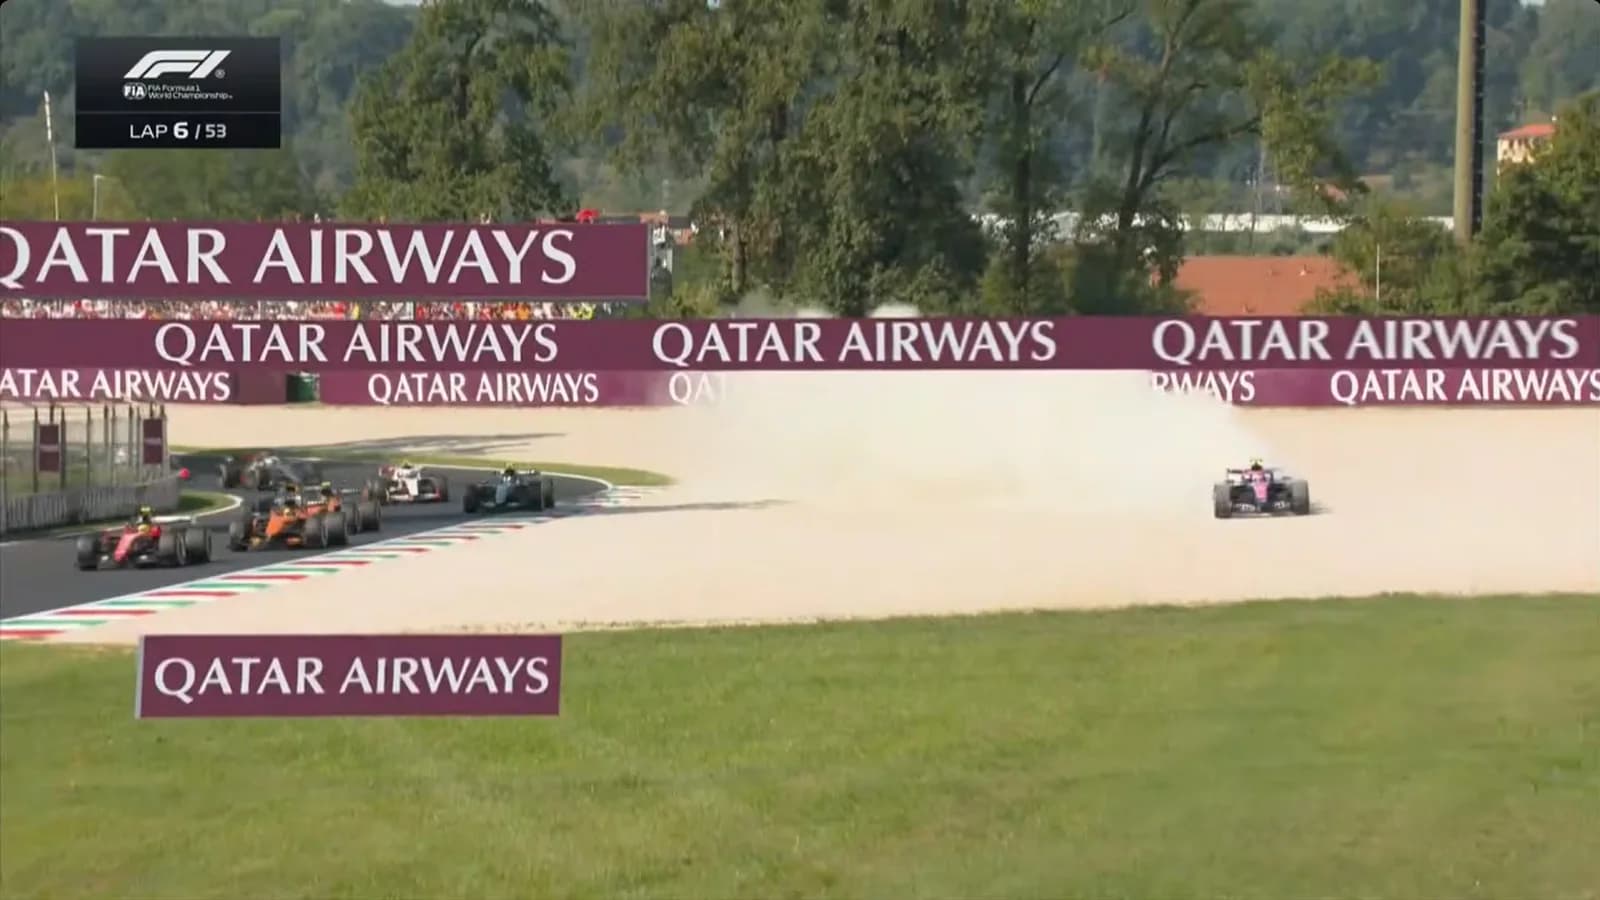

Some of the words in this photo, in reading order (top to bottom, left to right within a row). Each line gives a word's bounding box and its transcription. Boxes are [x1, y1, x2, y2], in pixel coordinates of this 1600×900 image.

[253, 228, 576, 284] AIRWAYS
[155, 323, 328, 365] QATAR
[343, 322, 558, 362] AIRWAYS
[652, 322, 825, 366] QATAR
[838, 321, 1057, 362] AIRWAYS
[1152, 320, 1332, 365] QATAR
[1346, 319, 1579, 360] AIRWAYS
[0, 369, 81, 398] ATAR
[90, 370, 230, 400] AIRWAYS
[368, 373, 467, 404] QATAR
[476, 372, 599, 402] AIRWAYS
[1331, 370, 1448, 404] QATAR
[154, 657, 325, 703] QATAR
[339, 656, 549, 694] AIRWAYS
